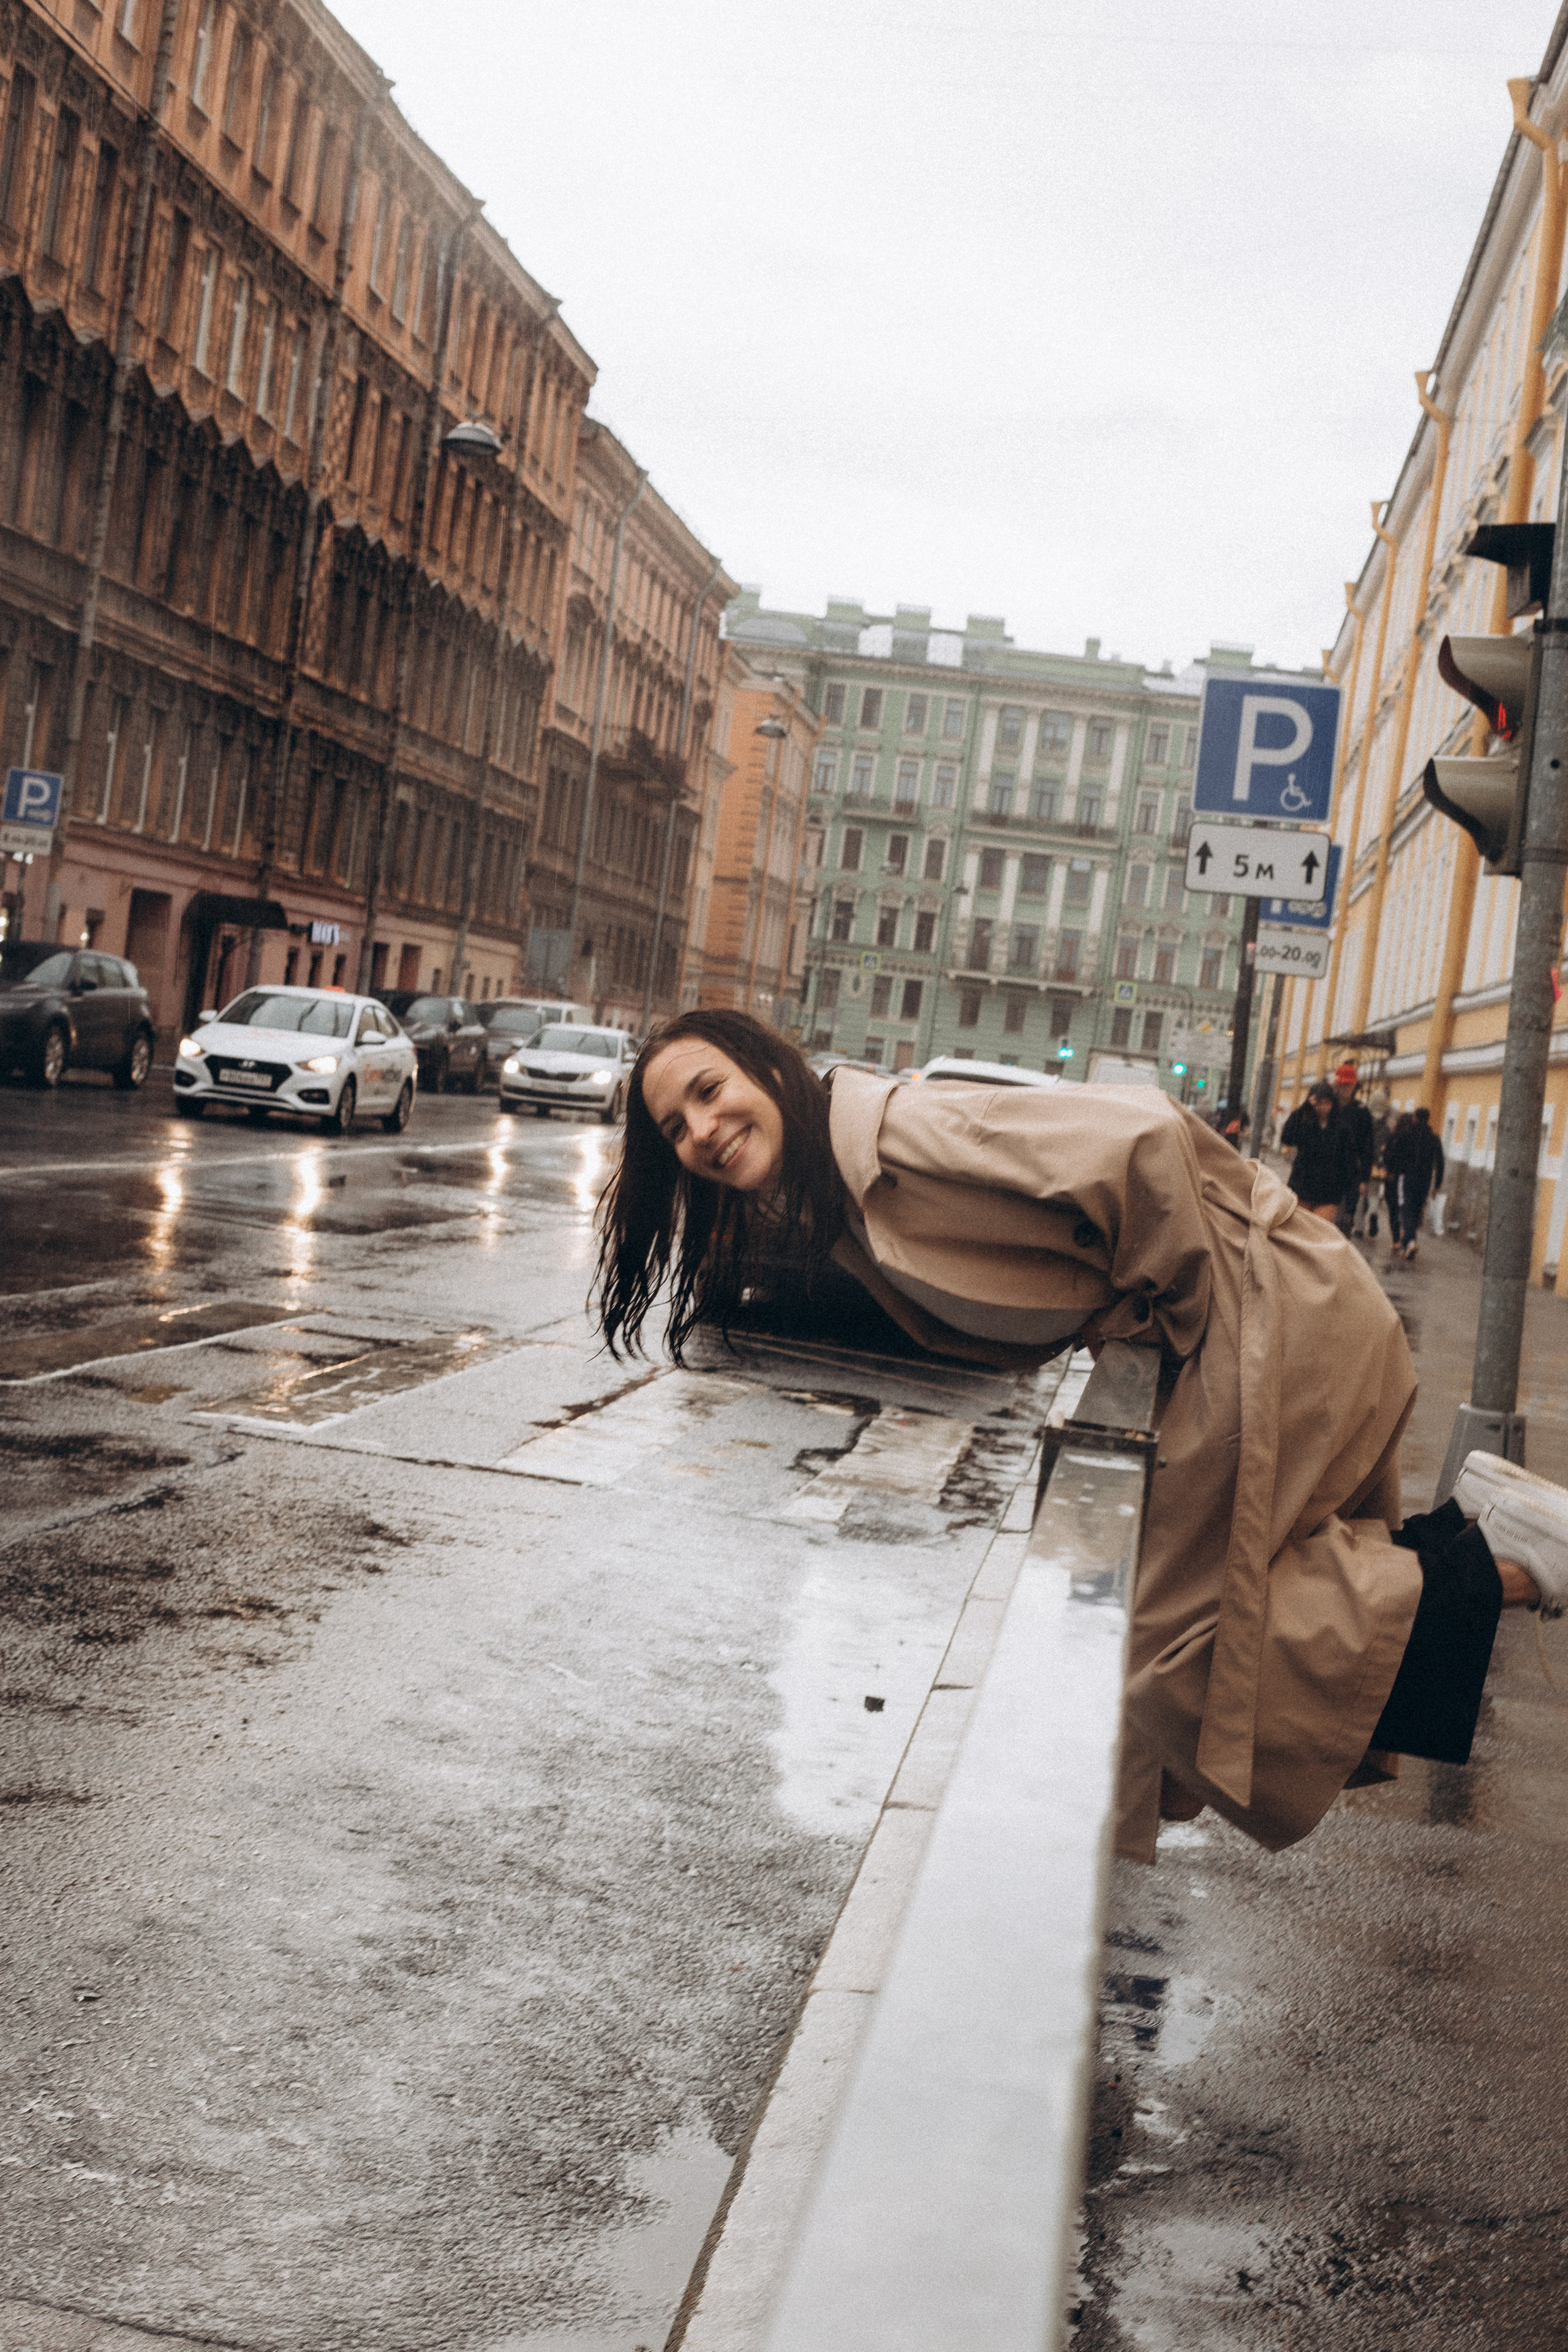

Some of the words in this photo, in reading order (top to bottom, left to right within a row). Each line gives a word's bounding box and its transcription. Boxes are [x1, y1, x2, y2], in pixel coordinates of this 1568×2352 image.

[1232, 695, 1313, 801] P
[17, 776, 50, 818] P
[1233, 854, 1249, 878] 5
[1256, 944, 1321, 963] .00-20.00
